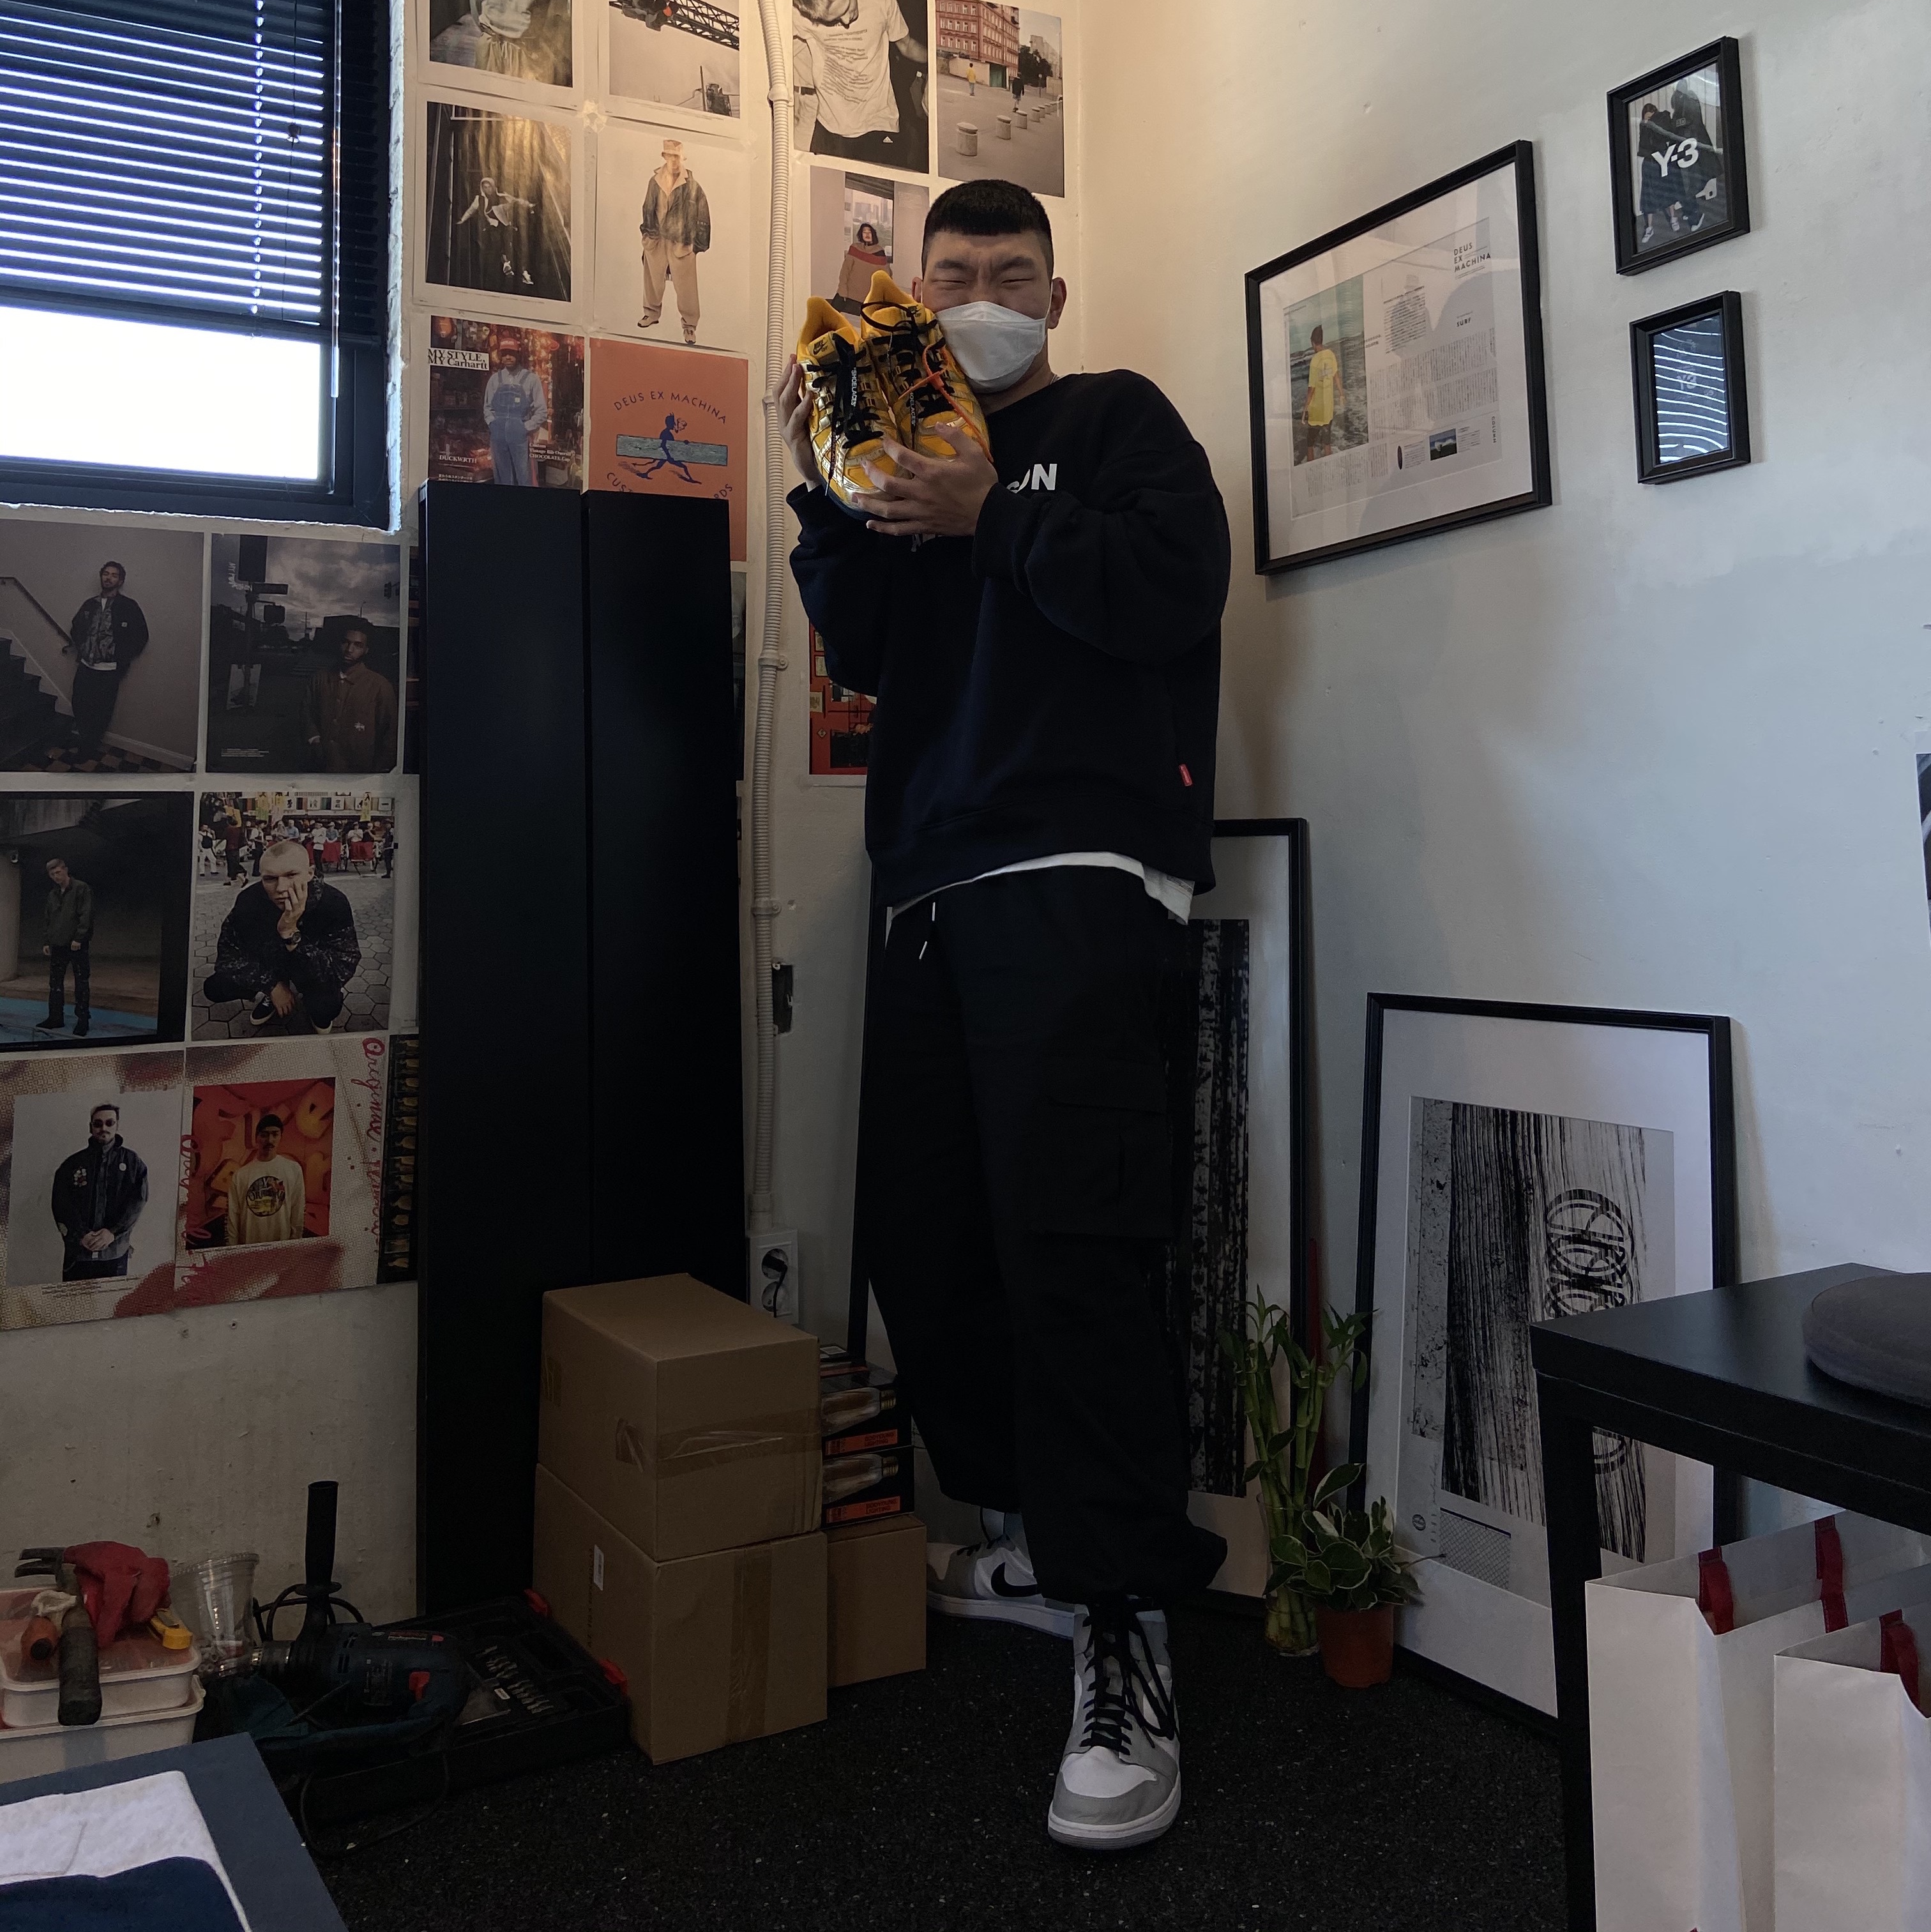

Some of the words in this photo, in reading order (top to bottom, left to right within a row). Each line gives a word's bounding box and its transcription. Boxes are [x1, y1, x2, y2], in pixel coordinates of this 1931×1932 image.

[1651, 138, 1699, 178] Y-3
[1453, 242, 1473, 256] DEUS
[1454, 255, 1462, 264] EX
[1455, 252, 1491, 273] MACHINA
[1456, 317, 1471, 328] SURF
[427, 348, 445, 358] MY
[427, 355, 445, 365] MY
[447, 357, 488, 370] Carhartt
[614, 392, 644, 411] DEUS
[650, 391, 664, 400] EX
[670, 392, 726, 425] MACHINA
[439, 454, 478, 464] DUCKWRTH
